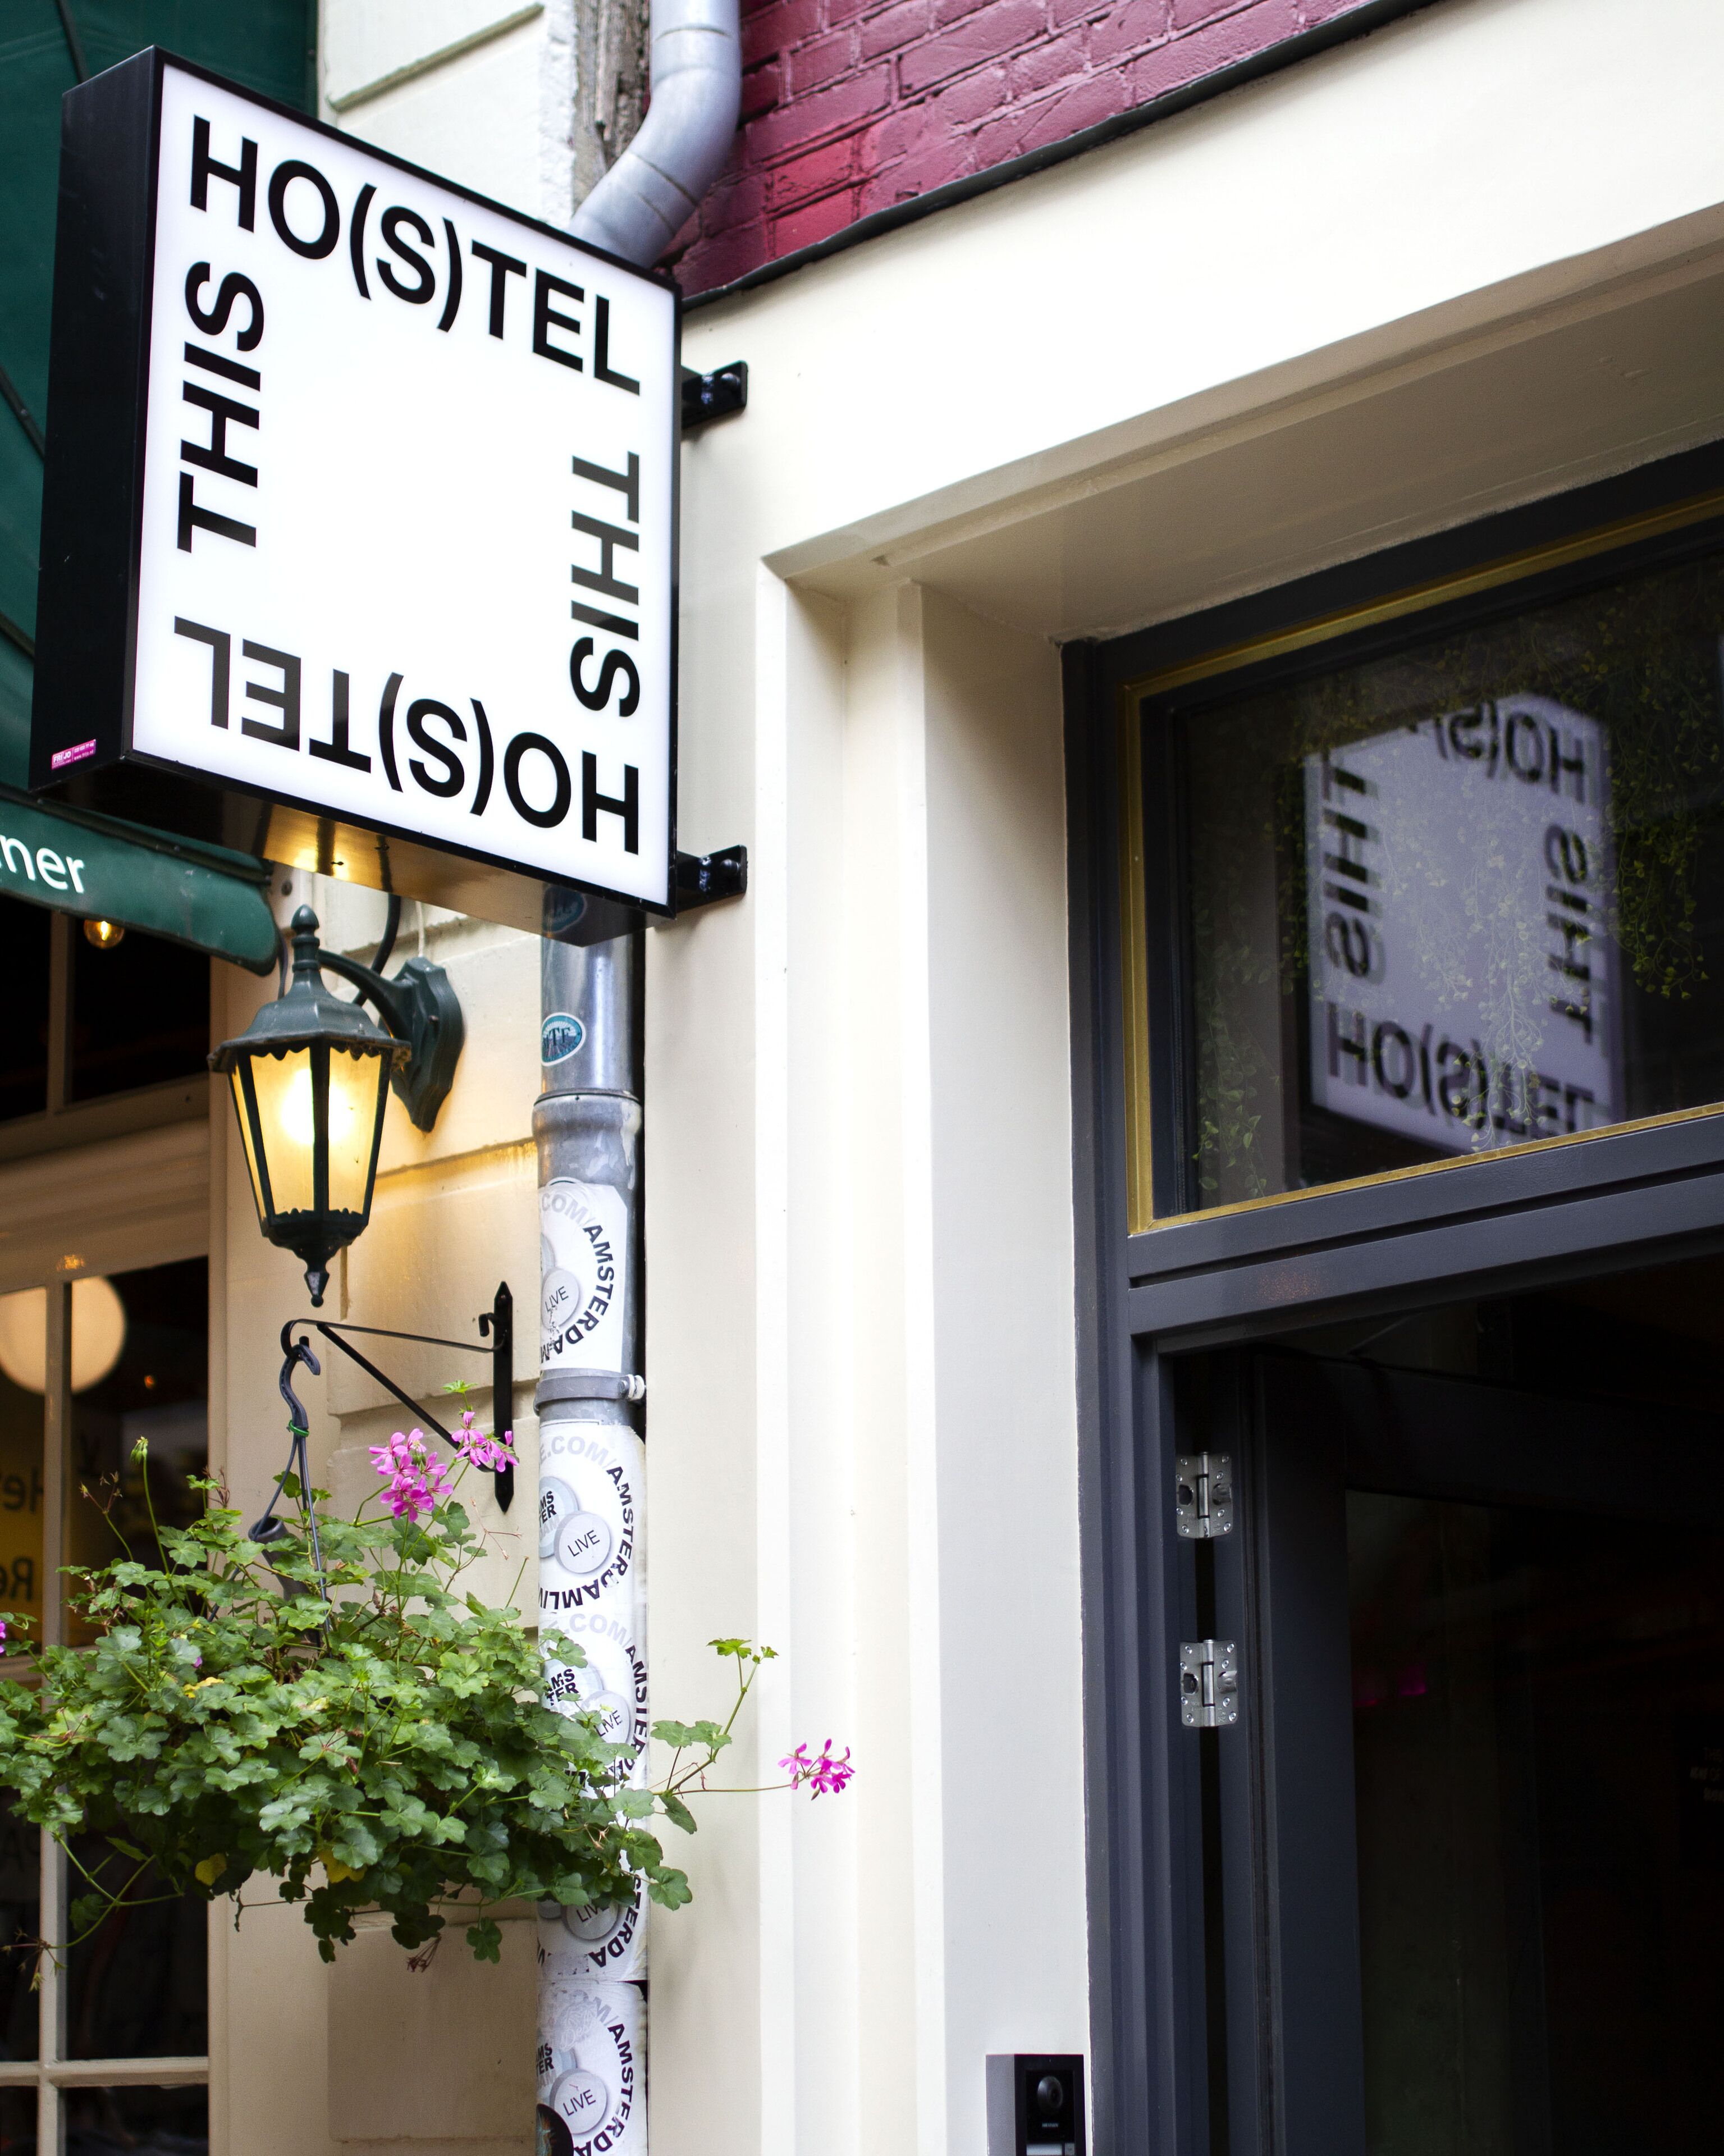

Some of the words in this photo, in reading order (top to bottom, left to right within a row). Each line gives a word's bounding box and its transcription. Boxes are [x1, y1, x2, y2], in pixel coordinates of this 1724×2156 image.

[190, 115, 640, 396] HO(S)TEL
[177, 262, 264, 553] THIS
[570, 451, 640, 718] THIS
[175, 616, 639, 855] HO(S)TEL
[0, 834, 84, 894] ner
[545, 1286, 569, 1313] LIVE
[568, 1530, 600, 1557] LIVE
[563, 2089, 596, 2116] LIVE
